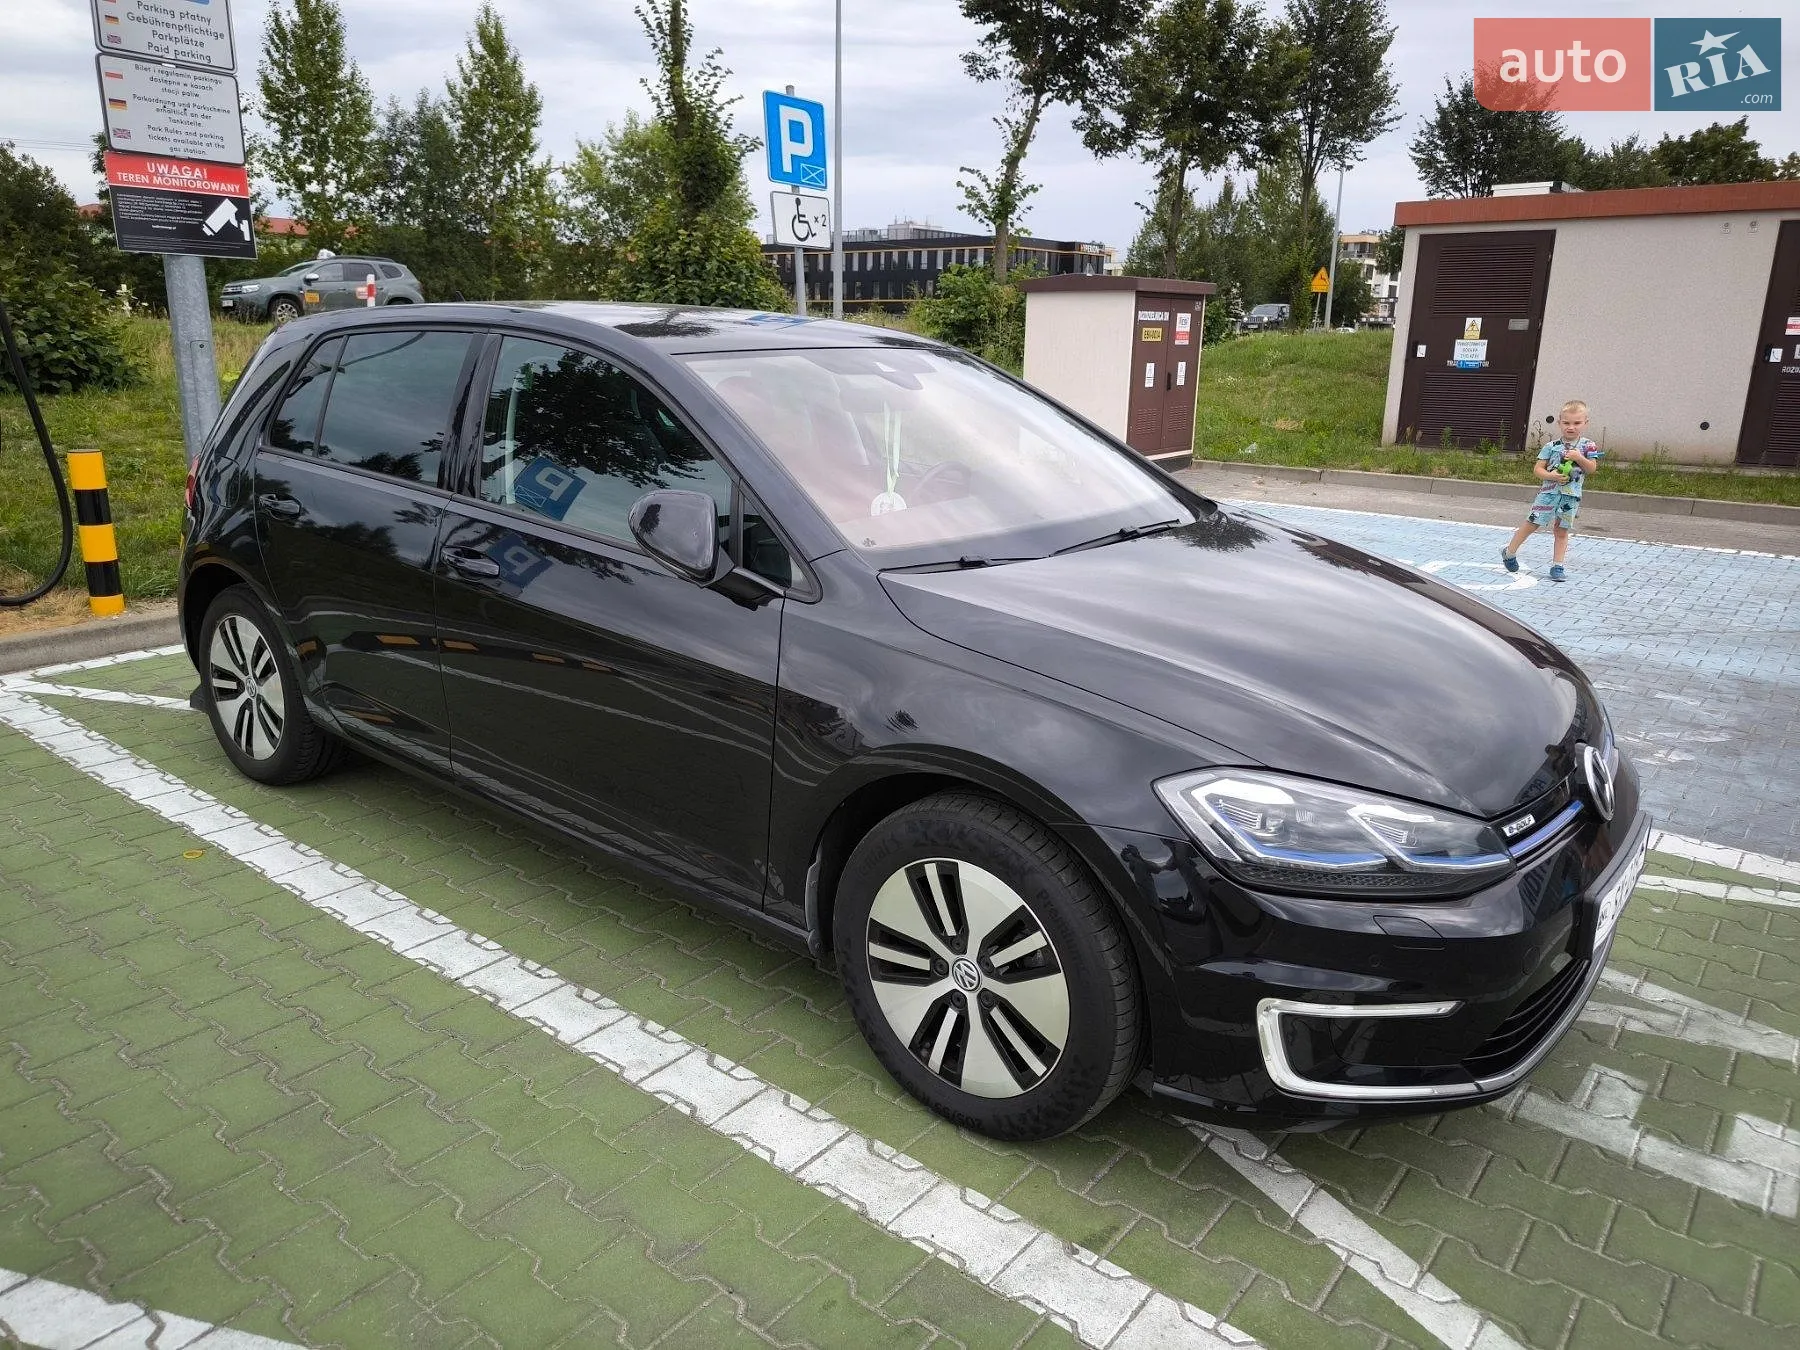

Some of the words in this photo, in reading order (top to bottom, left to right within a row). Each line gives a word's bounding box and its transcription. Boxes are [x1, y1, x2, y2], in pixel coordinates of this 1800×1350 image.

[137, 0, 176, 19] Parking
[179, 10, 212, 25] płatny
[126, 12, 225, 40] Gebührenpflichtige
[152, 30, 205, 48] Parkplätze
[147, 42, 170, 54] Paid
[174, 49, 212, 63] parking
[148, 134, 171, 142] tickets
[173, 138, 204, 146] available
[200, 132, 224, 141] parking
[778, 104, 814, 173] P
[147, 161, 208, 179] UWAGA!
[117, 172, 150, 184] TEREN
[152, 177, 241, 193] MONITOROWANY
